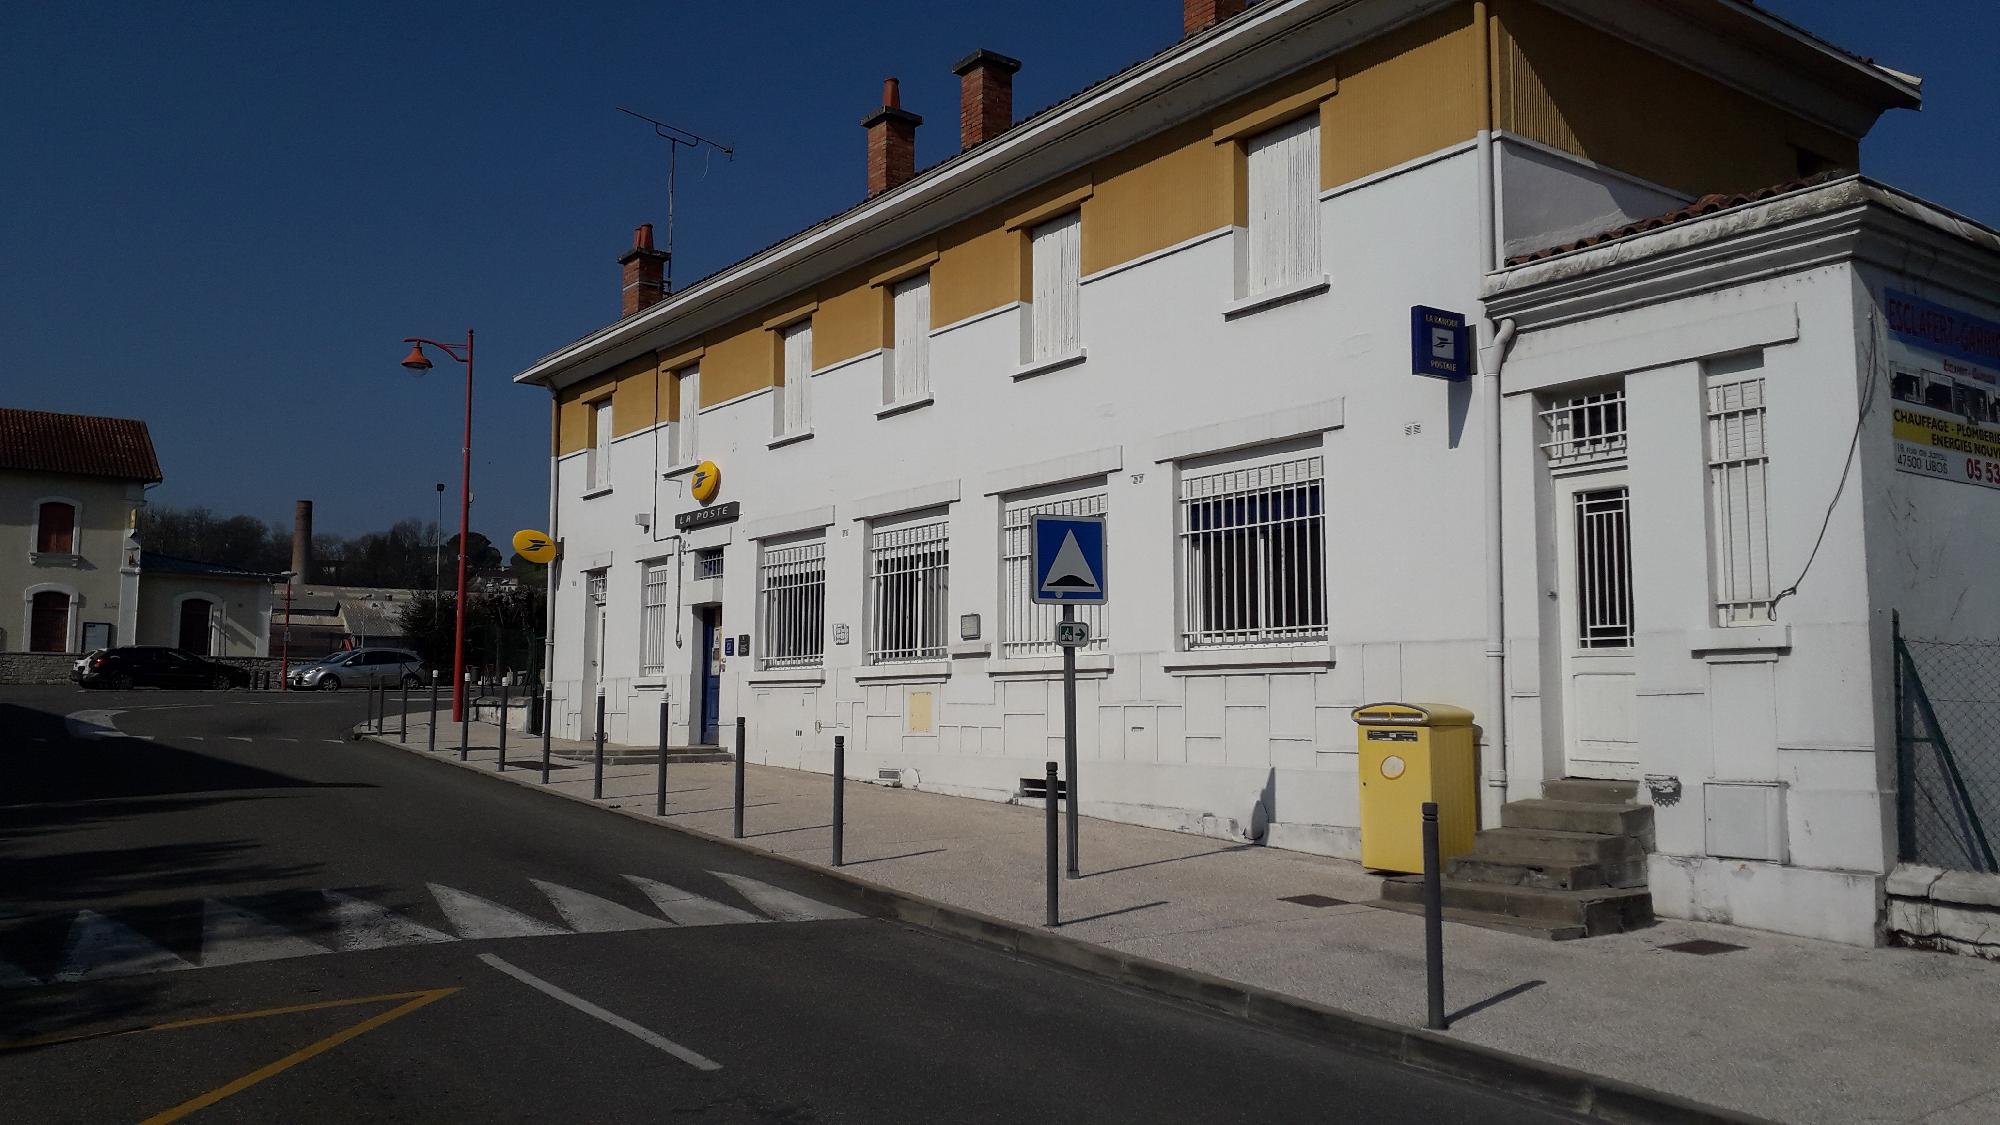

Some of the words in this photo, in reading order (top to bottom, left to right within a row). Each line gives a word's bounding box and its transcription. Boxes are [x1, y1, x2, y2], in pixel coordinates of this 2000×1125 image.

[1425, 313, 1434, 323] LA
[1430, 359, 1457, 372] POSTALE
[1893, 408, 1949, 433] CHAUFFAGE
[1931, 433, 1973, 454] ENERGIES
[1897, 454, 1921, 470] 47500
[1966, 457, 1982, 480] 05
[1986, 461, 2000, 484] 53
[679, 514, 691, 525] LA
[696, 506, 728, 520] POSTE
